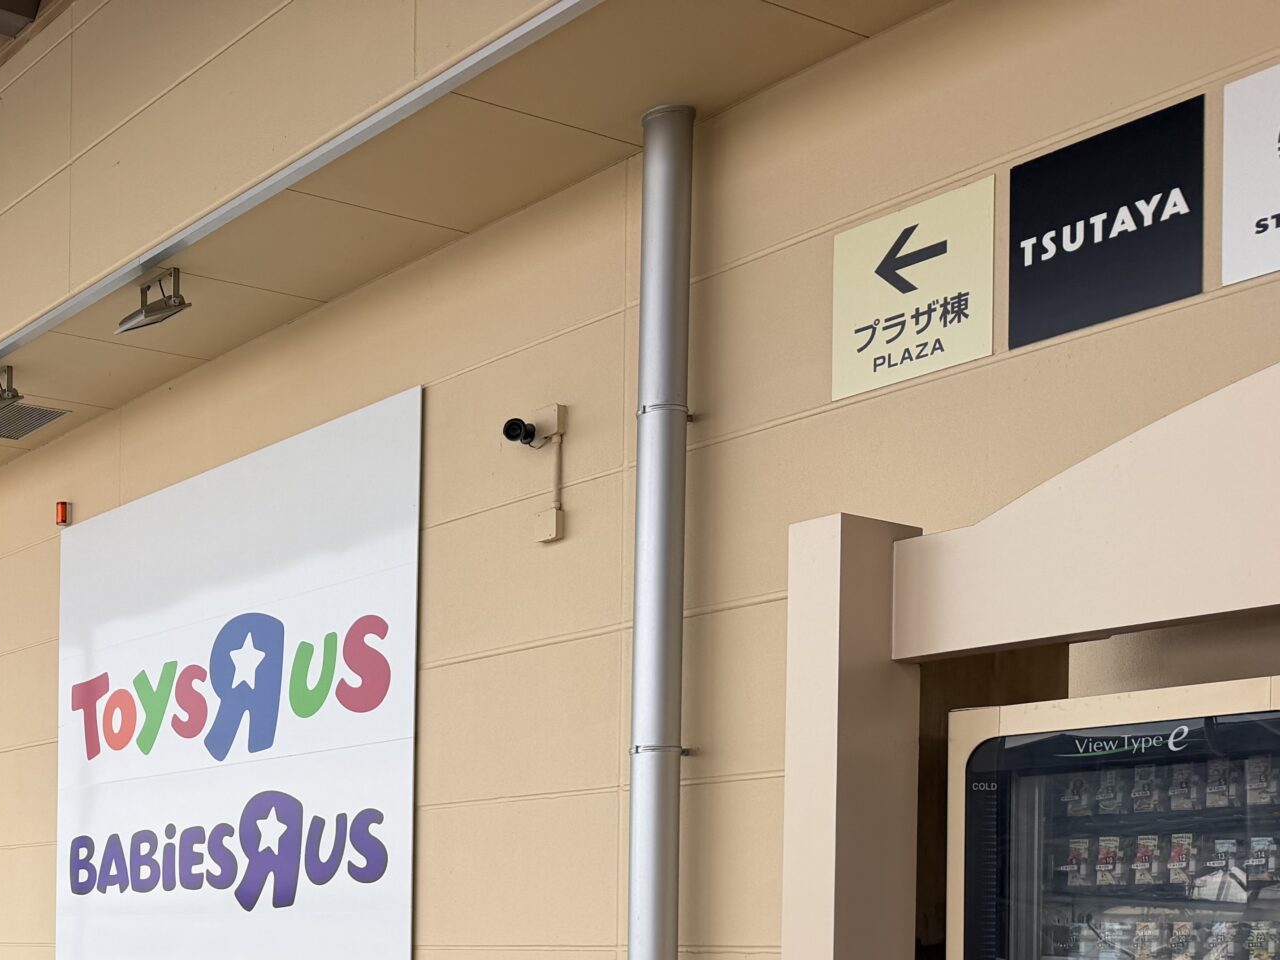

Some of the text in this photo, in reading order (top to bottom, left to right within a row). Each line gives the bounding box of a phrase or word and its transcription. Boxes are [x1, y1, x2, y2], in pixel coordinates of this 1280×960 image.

[1020, 187, 1190, 267] TSUTAYA
[854, 292, 970, 353] プラザ棟
[873, 338, 945, 372] PLAZA
[1075, 725, 1189, 754] View Type e
[972, 782, 997, 791] COLD
